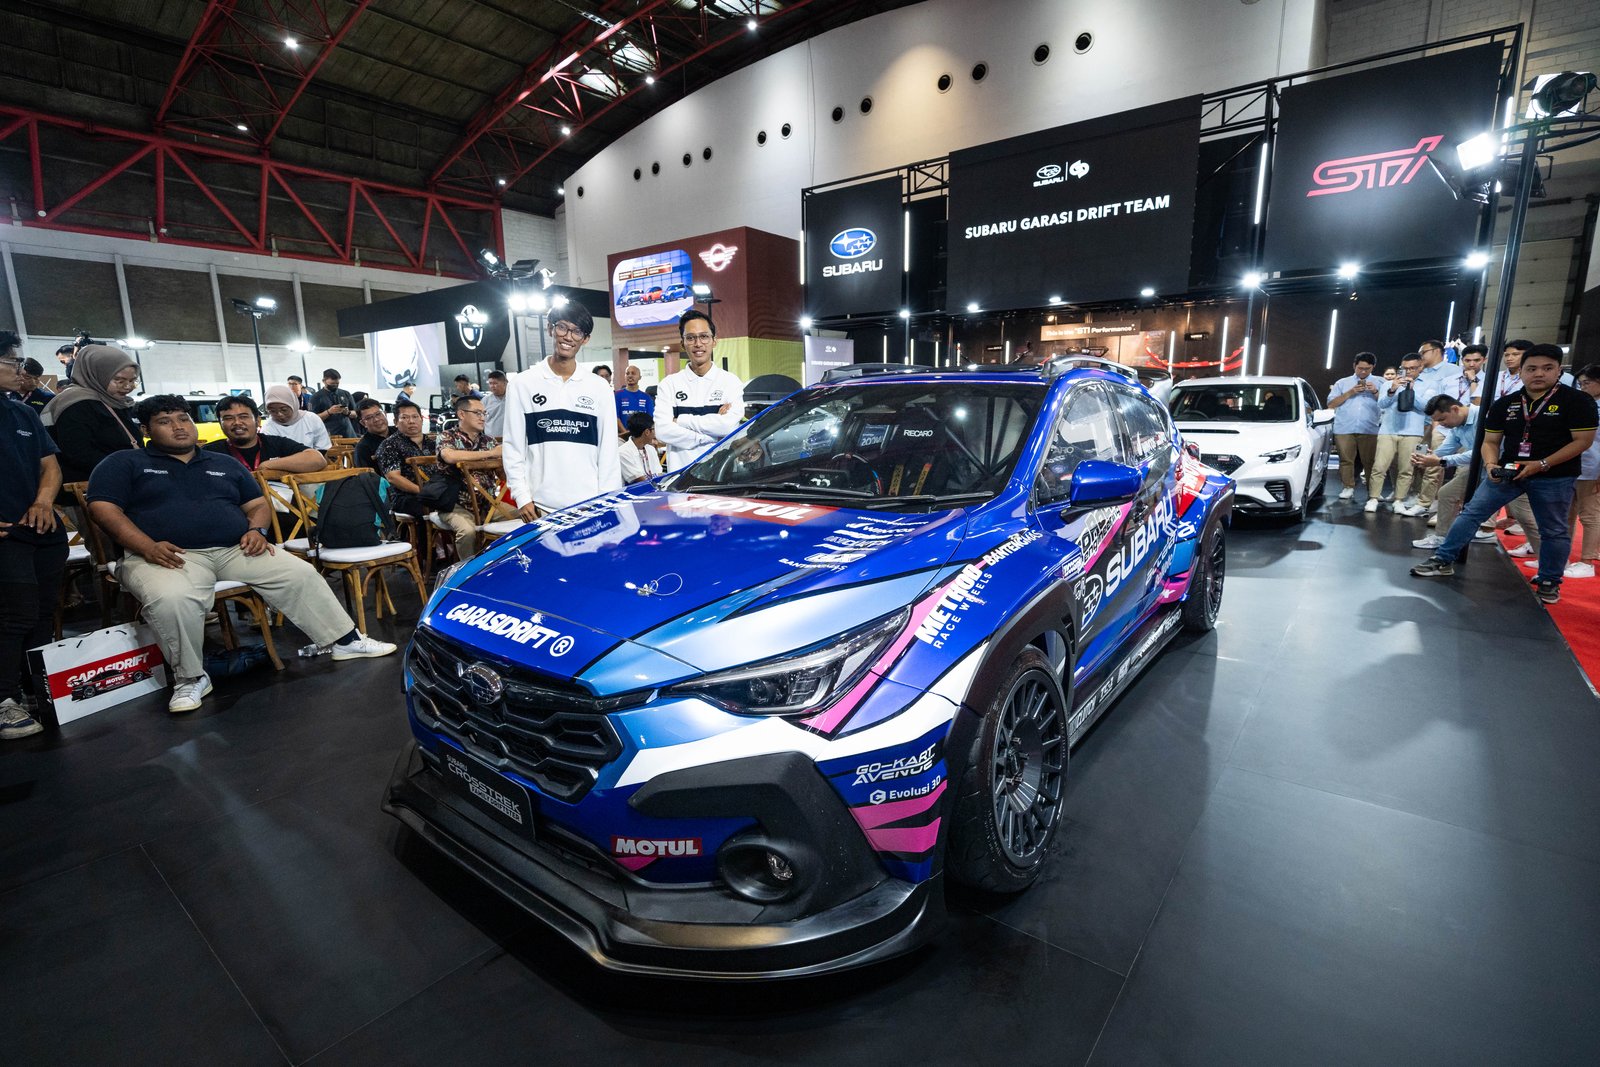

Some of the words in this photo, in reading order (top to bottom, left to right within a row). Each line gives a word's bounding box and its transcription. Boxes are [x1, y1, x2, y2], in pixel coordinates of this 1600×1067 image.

[1032, 176, 1065, 187] SUBARU
[1306, 135, 1444, 197] STI
[964, 220, 1018, 240] SUBARU
[1020, 210, 1073, 231] GARASI
[1076, 202, 1122, 222] DRIFT
[1123, 194, 1171, 215] TEAM
[822, 258, 884, 278] SUBARU
[552, 419, 590, 428] SUBARU
[903, 429, 934, 437] RECARO
[671, 498, 813, 520] MOTUL
[982, 529, 1043, 566] BANTENGMAS
[1106, 490, 1174, 598] SUBARU
[914, 563, 983, 645] METHOD
[933, 616, 962, 649] RACE
[959, 573, 993, 612] WHEELS
[446, 603, 561, 649] GARASIDRIFT
[851, 757, 934, 787] AVENUE
[856, 743, 937, 776] GO-KART
[447, 762, 521, 814] CROSSTREK
[889, 782, 931, 800] Evolusi
[930, 774, 941, 790] 3D
[615, 837, 699, 856] MOTUL
